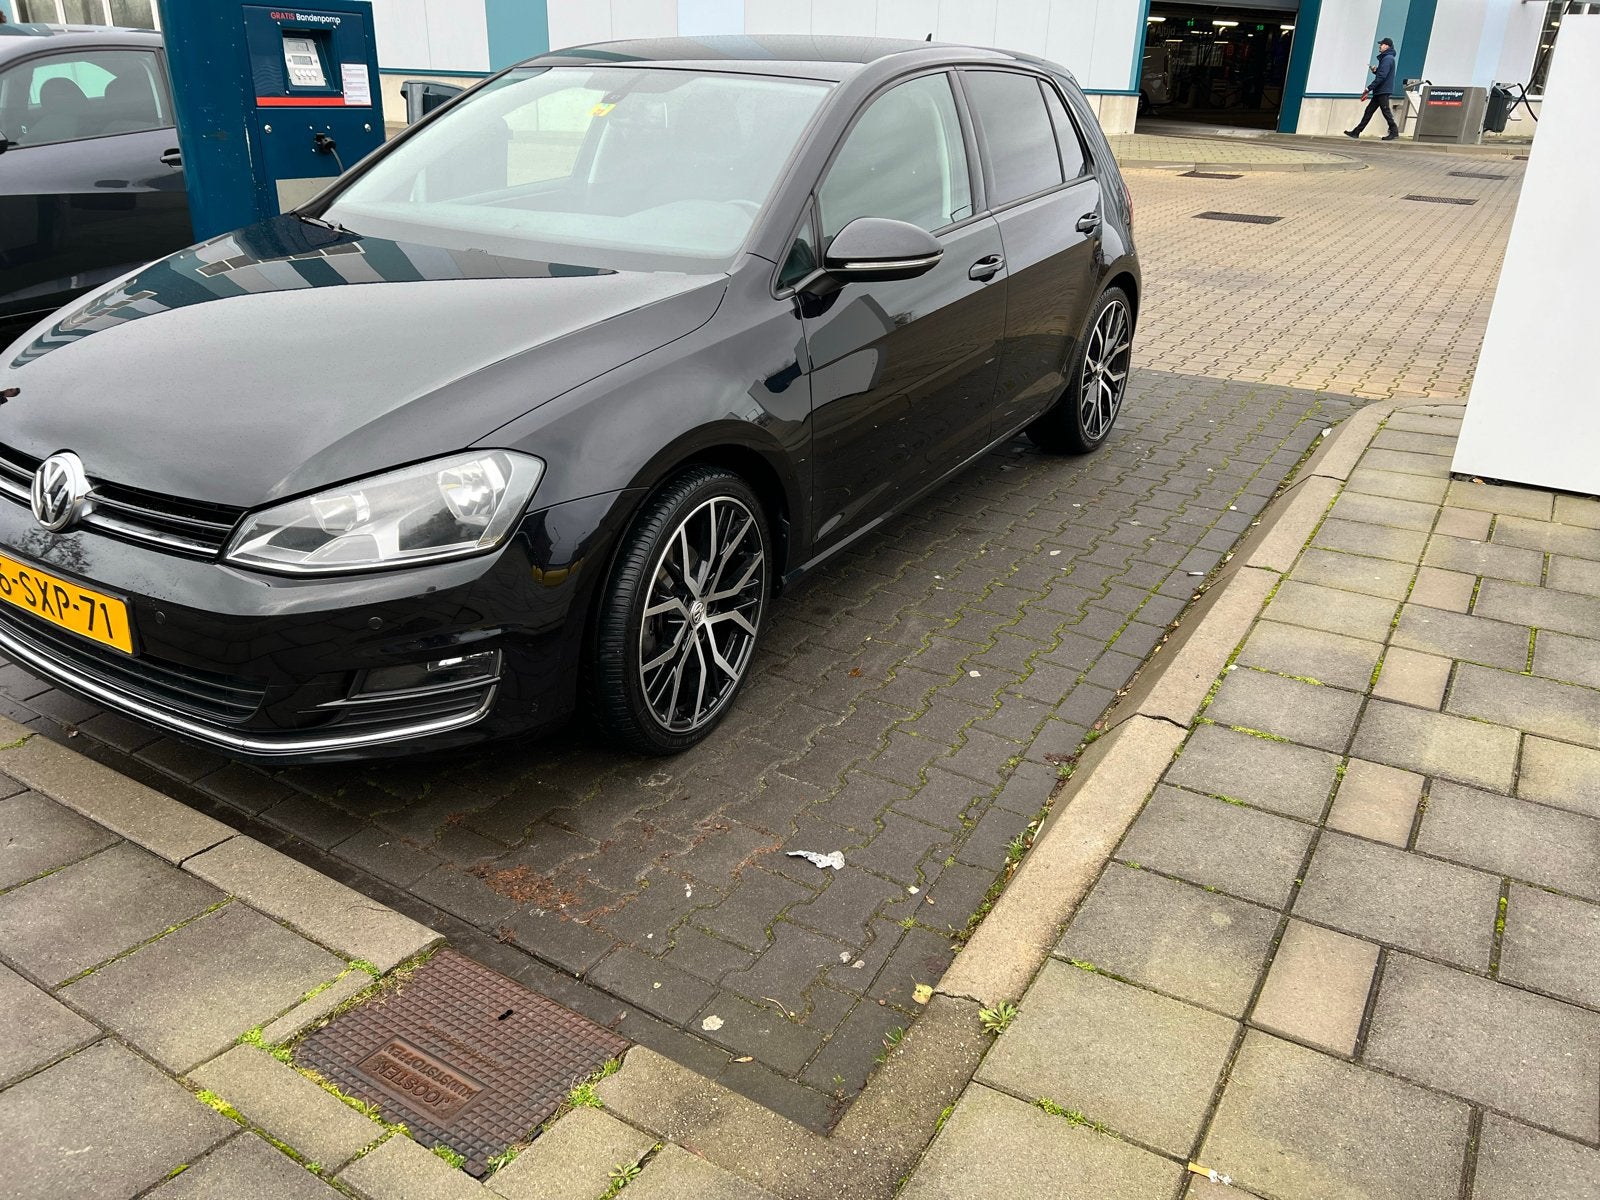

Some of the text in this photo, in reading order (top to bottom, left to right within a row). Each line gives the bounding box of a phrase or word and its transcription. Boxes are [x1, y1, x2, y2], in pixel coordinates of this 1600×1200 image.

[270, 11, 341, 25] GRATIS Bandenpomp
[373, 1060, 450, 1107] JOOSTEN
[384, 1043, 476, 1100] KUNSTSTOFFEN
